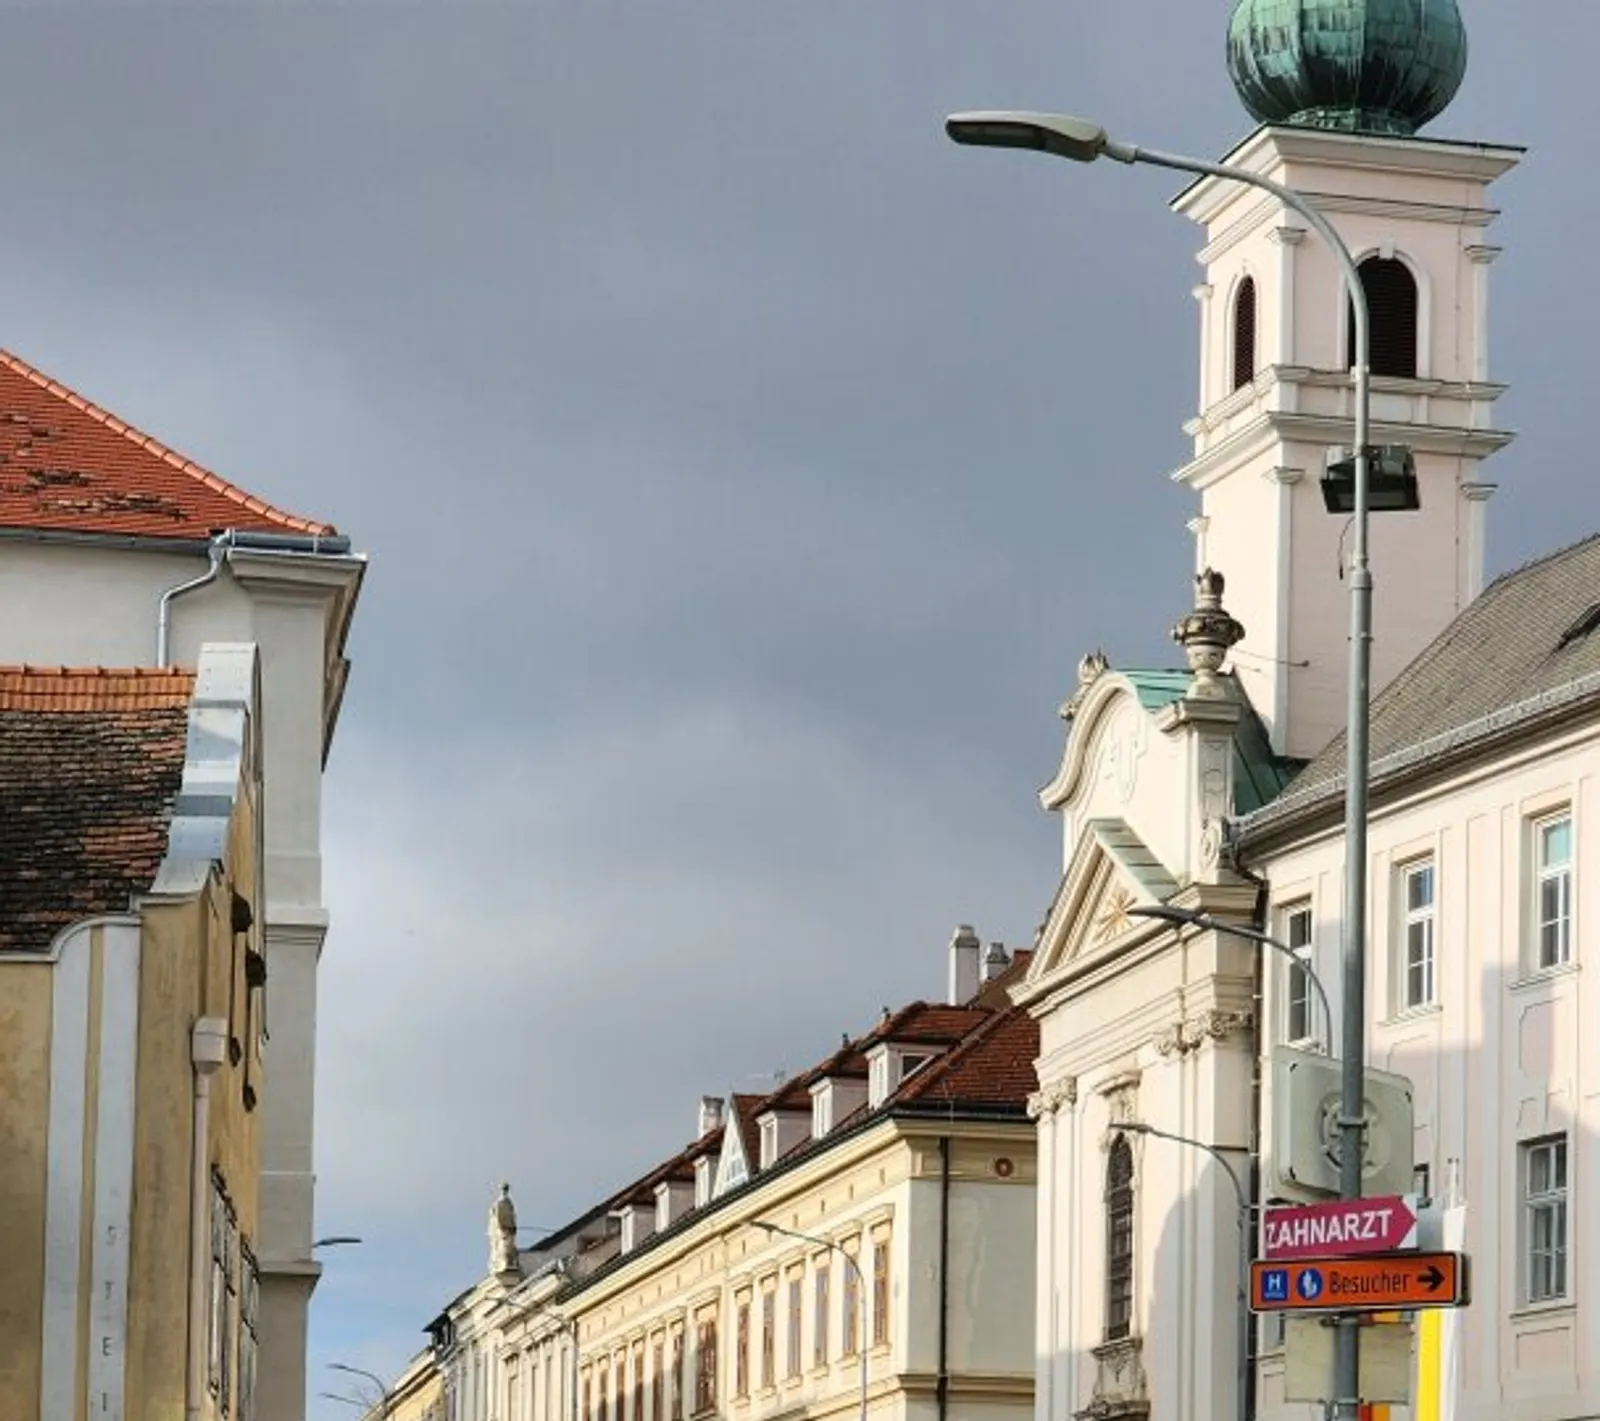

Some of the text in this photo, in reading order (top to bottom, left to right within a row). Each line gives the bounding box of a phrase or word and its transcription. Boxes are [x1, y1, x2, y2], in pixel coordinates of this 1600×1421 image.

[1266, 1209, 1393, 1249] ZAHNARZT
[1268, 1270, 1412, 1295] H Besucher
